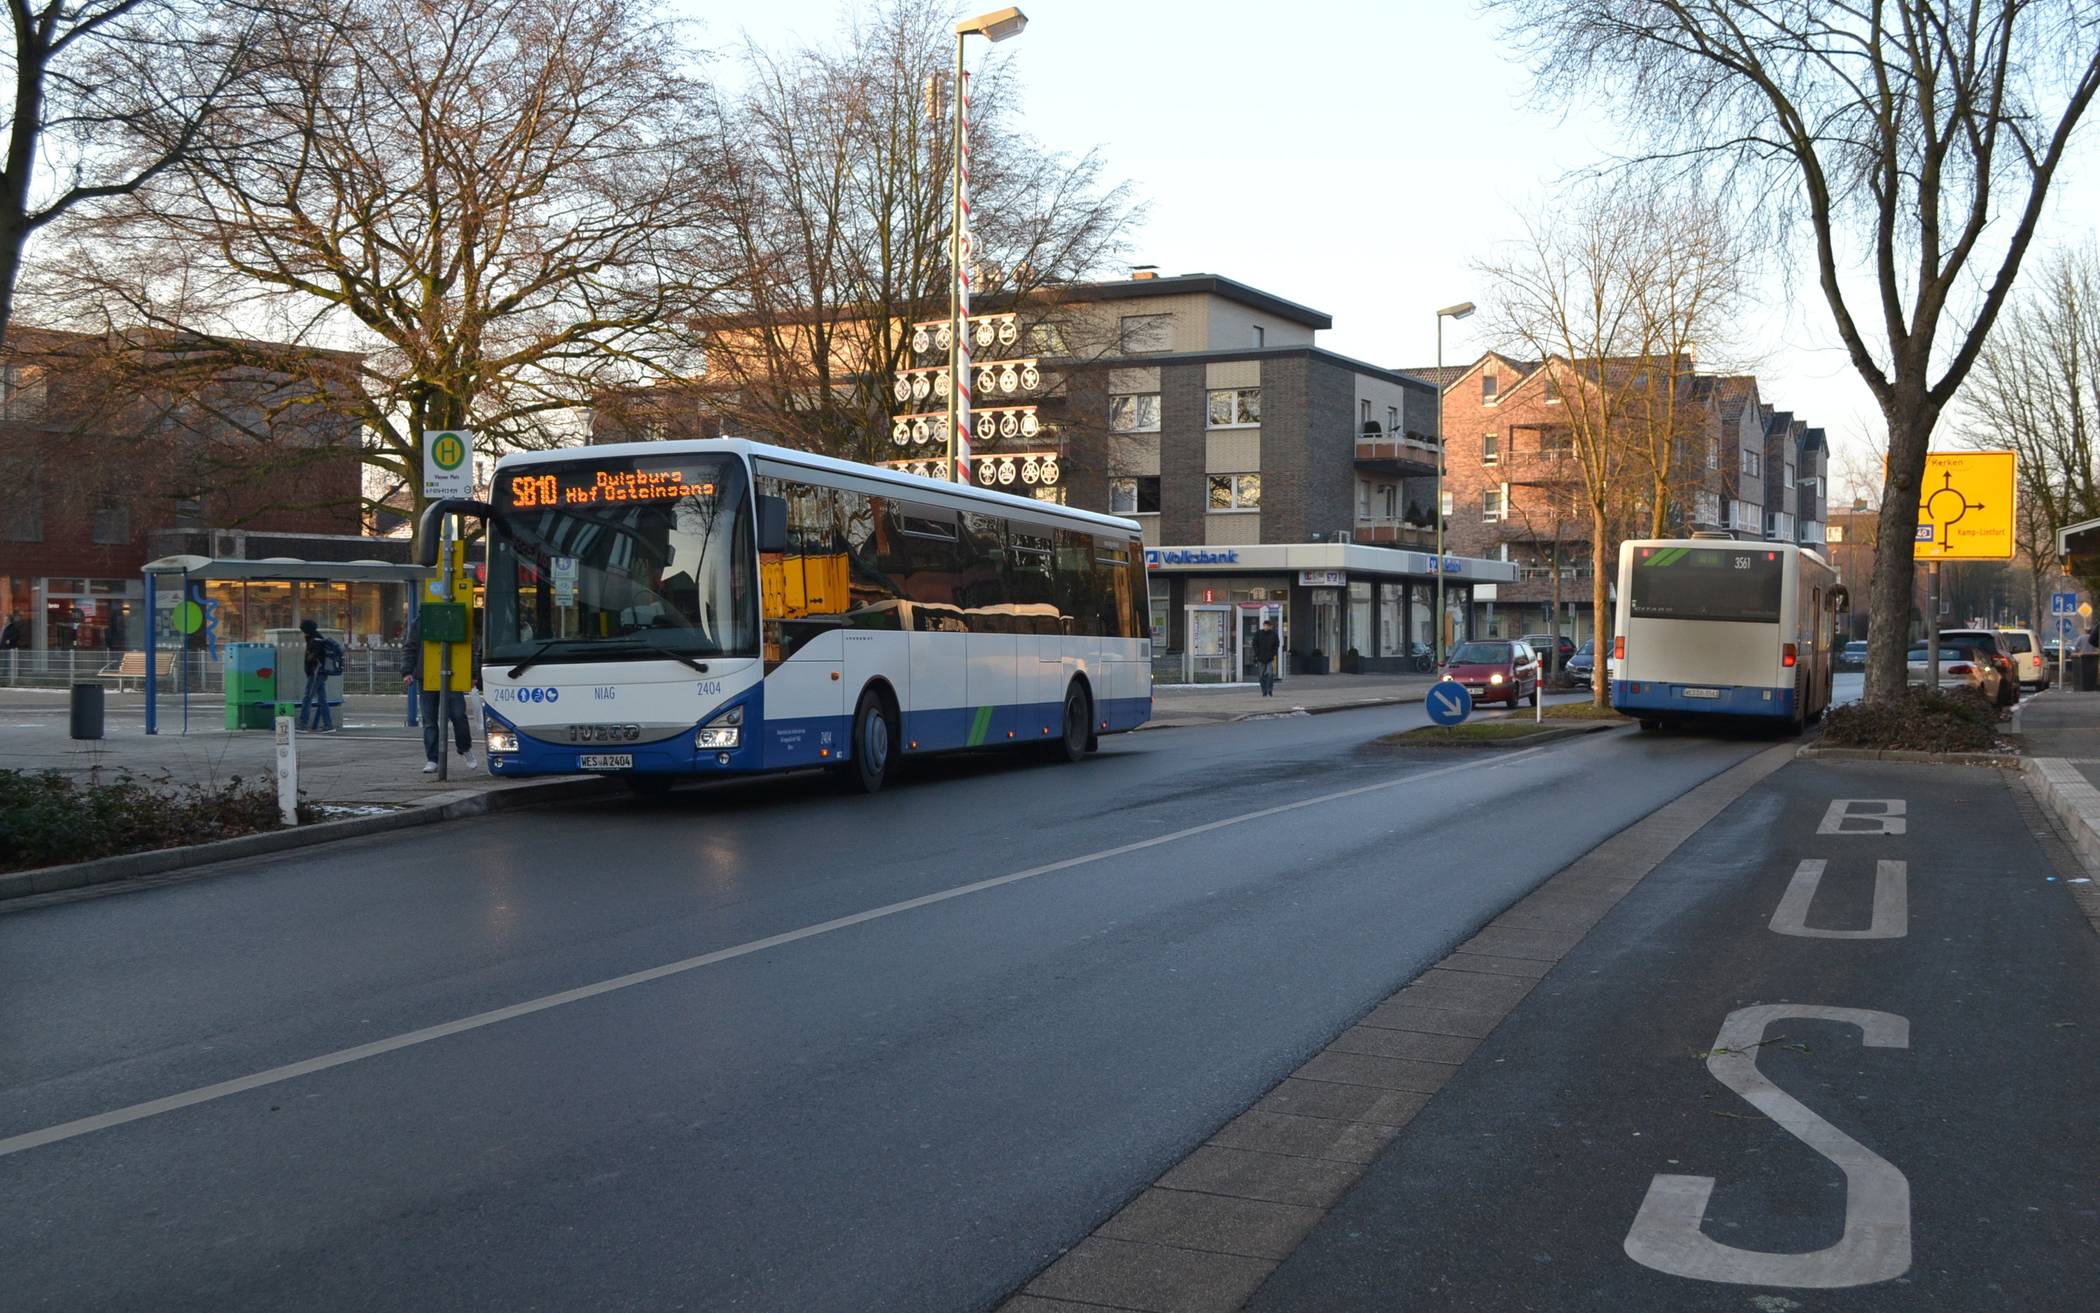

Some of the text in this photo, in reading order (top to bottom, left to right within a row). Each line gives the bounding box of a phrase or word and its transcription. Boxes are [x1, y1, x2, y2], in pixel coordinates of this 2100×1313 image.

[441, 441, 455, 462] H
[1931, 459, 1964, 467] Kerken
[512, 475, 558, 507] SB10
[566, 486, 598, 503] Hbf
[1957, 528, 2006, 537] Kamp-Lintfort
[1162, 549, 1239, 565] Volksbank
[1734, 556, 1751, 569] 3561
[494, 688, 515, 701] 2404
[594, 686, 616, 700] NIAG
[697, 681, 721, 696] 2404
[568, 724, 641, 741] IVECO
[581, 756, 598, 767] WES
